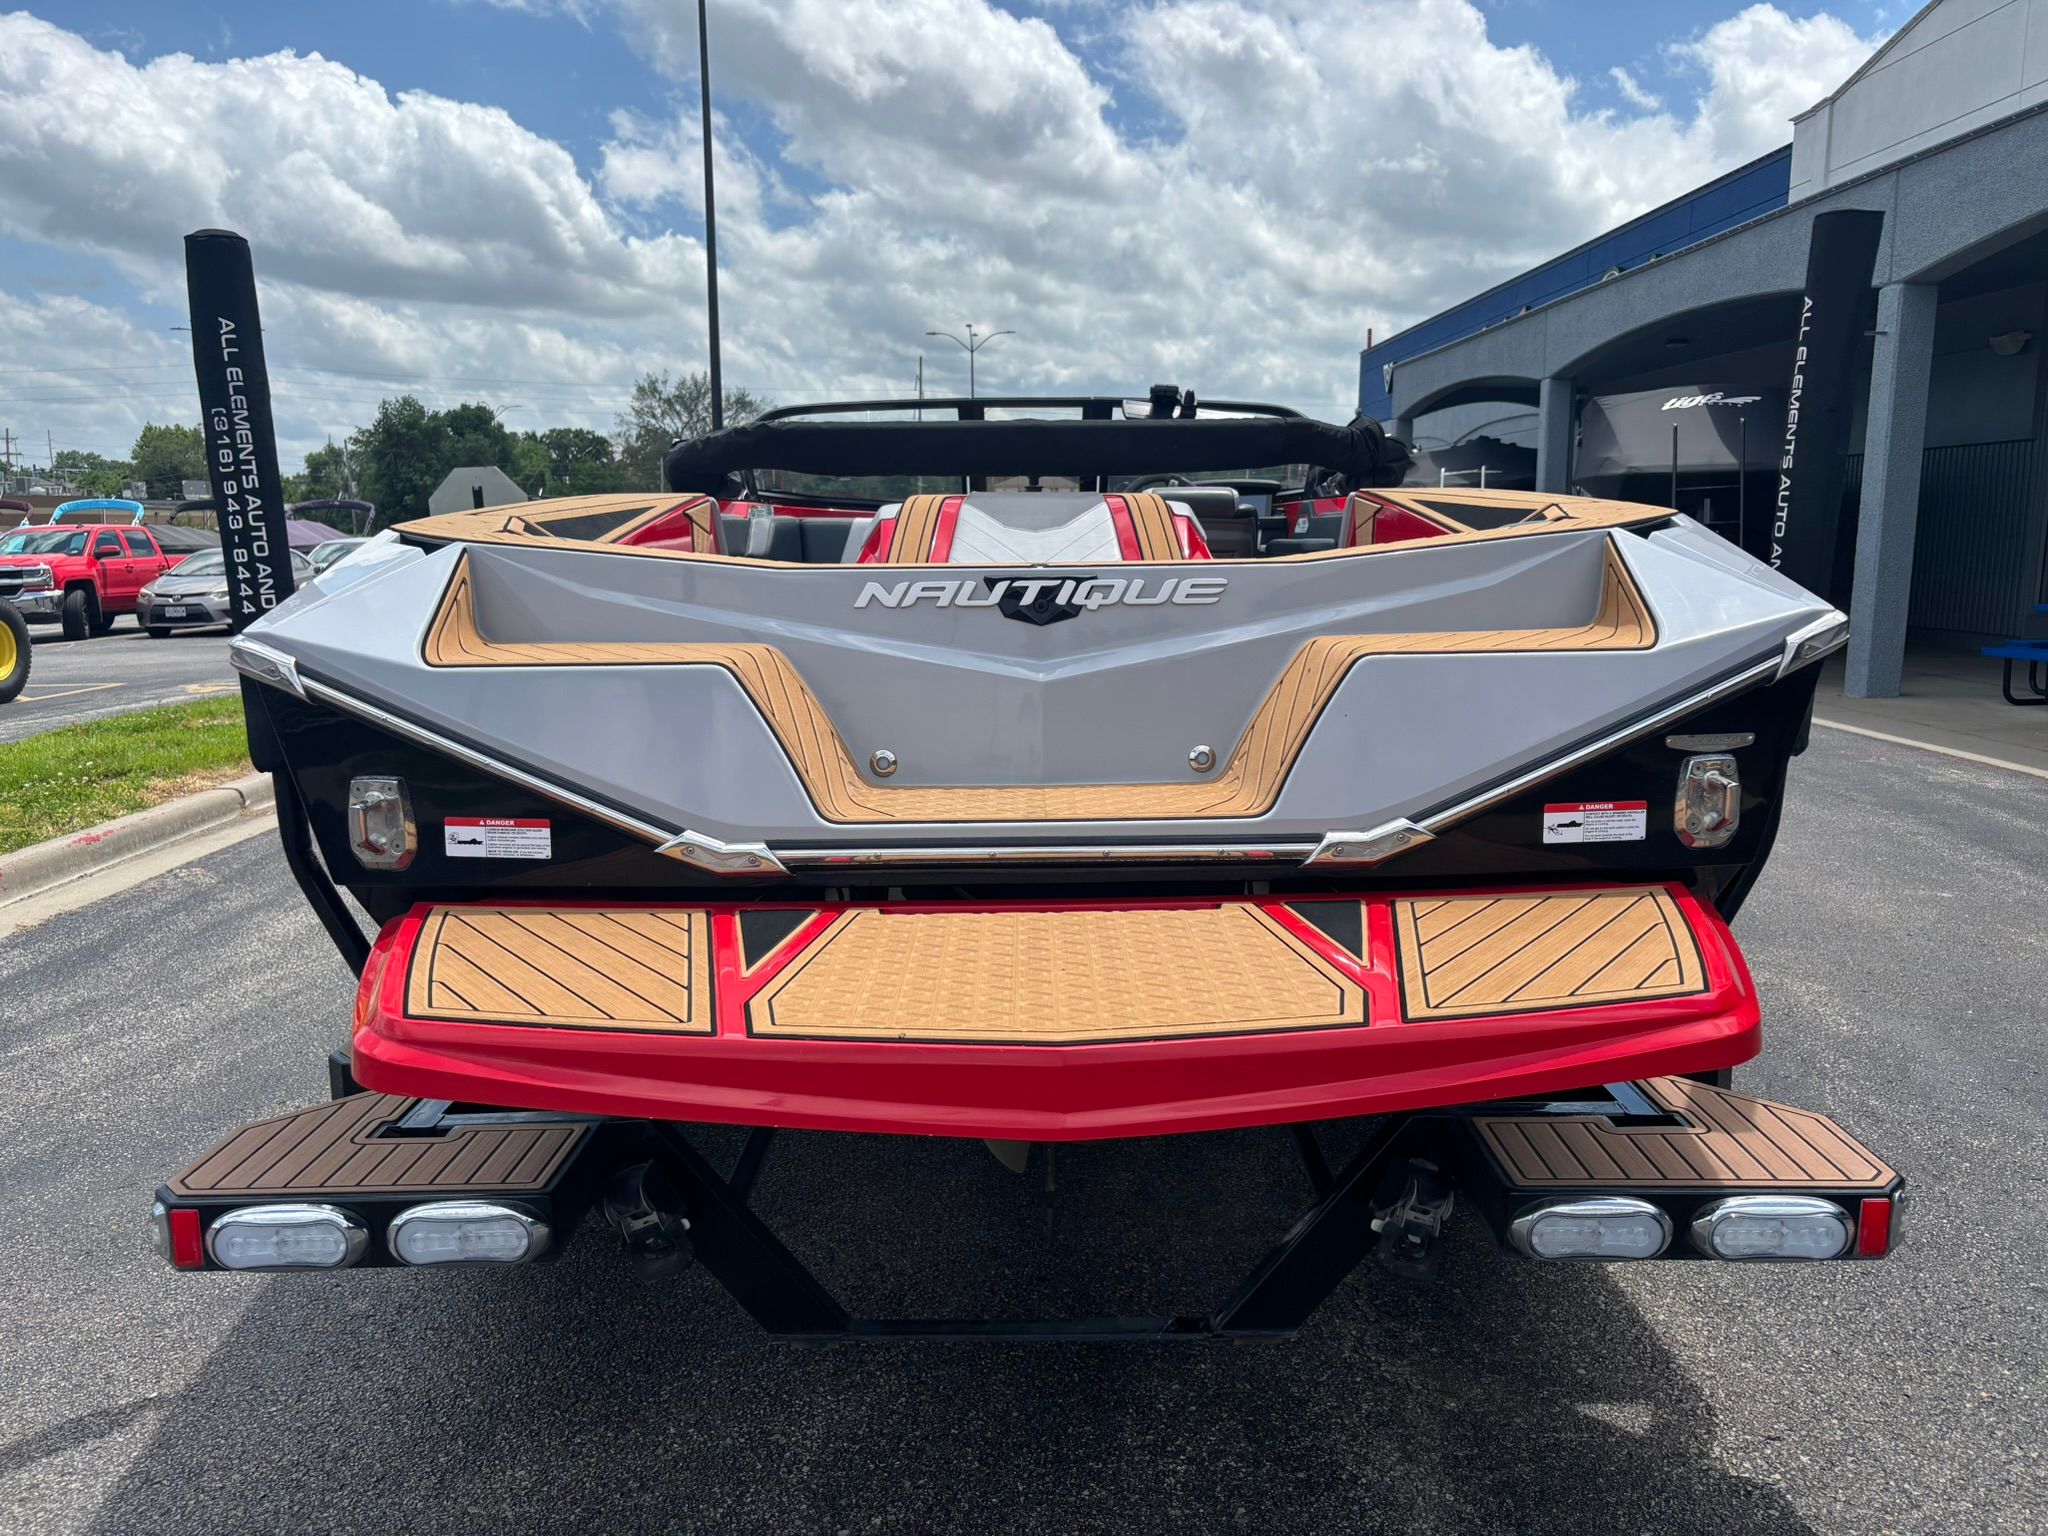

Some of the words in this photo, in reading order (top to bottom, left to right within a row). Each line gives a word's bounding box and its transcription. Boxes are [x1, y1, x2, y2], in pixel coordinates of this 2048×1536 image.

[217, 315, 240, 362] ALL
[1799, 296, 1814, 341] ALL
[225, 366, 260, 489] ELEMENTS
[1781, 346, 1807, 469] ELEMENTS
[211, 407, 236, 473] (316)
[244, 494, 270, 557] AUTO
[1774, 474, 1791, 537] AUTO
[223, 480, 257, 614] 943-8444
[256, 561, 277, 609] AND
[853, 577, 1229, 611] NAUTIQUE
